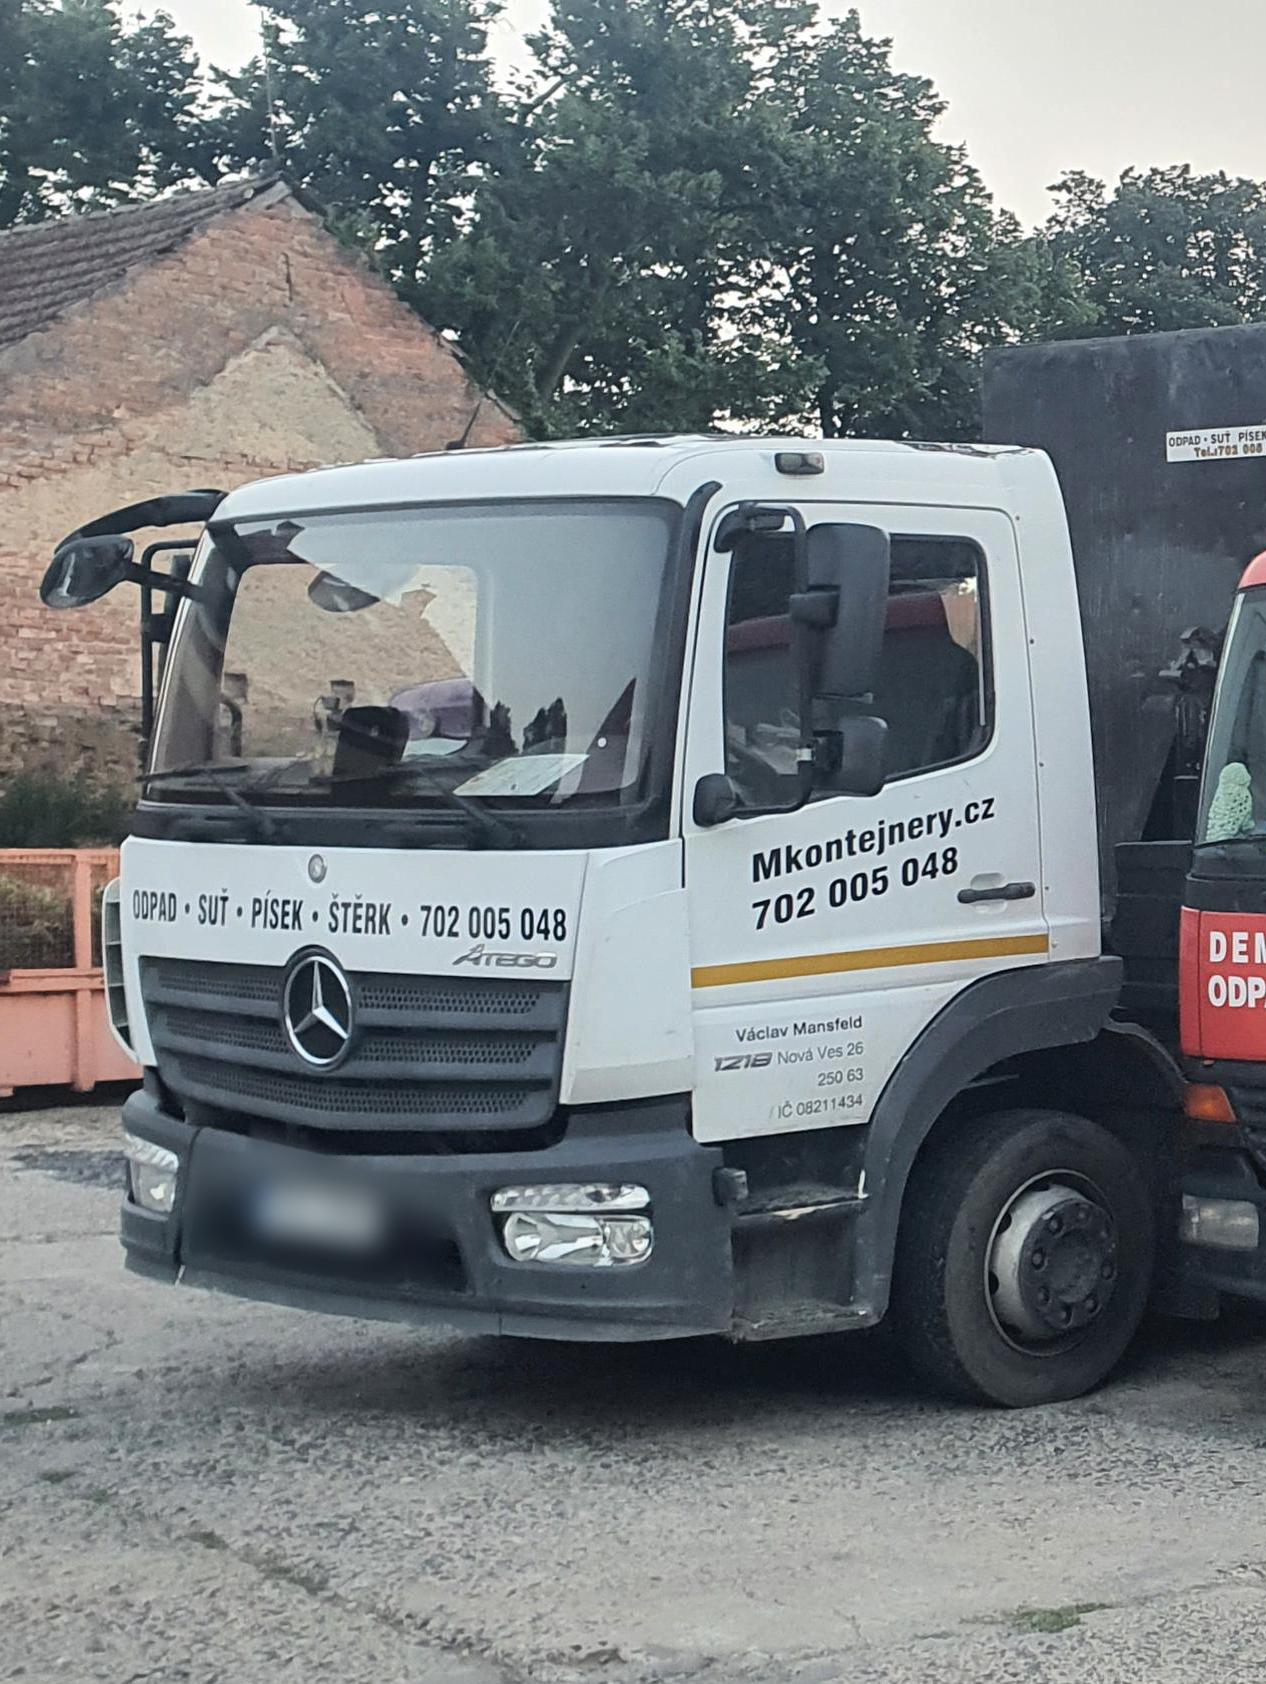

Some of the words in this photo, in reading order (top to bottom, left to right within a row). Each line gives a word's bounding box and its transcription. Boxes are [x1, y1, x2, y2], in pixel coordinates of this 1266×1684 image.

[1168, 434, 1202, 448] ODPAD
[1210, 430, 1231, 444] SUŤ
[752, 797, 996, 883] Mkontejnery.cz
[752, 887, 816, 931] 702
[828, 866, 889, 909] 005
[901, 847, 958, 887] 048
[132, 889, 177, 923] ODPAD
[198, 888, 229, 927] SUŤ
[251, 890, 303, 931] PÍSEK
[328, 892, 392, 936] ŠTĚRK
[420, 904, 460, 938] 702
[468, 906, 511, 940] 005
[520, 908, 567, 942] 048
[736, 1026, 789, 1042] Václav
[793, 1015, 863, 1036] Mansfeld
[714, 1052, 773, 1072] 1218
[777, 1048, 813, 1064] Nová
[817, 1045, 843, 1060] Ves
[847, 1041, 864, 1056] 26
[817, 1070, 843, 1086] 250
[847, 1068, 864, 1082] 63
[778, 1101, 793, 1118] IČ
[796, 1094, 863, 1116] 08211434
